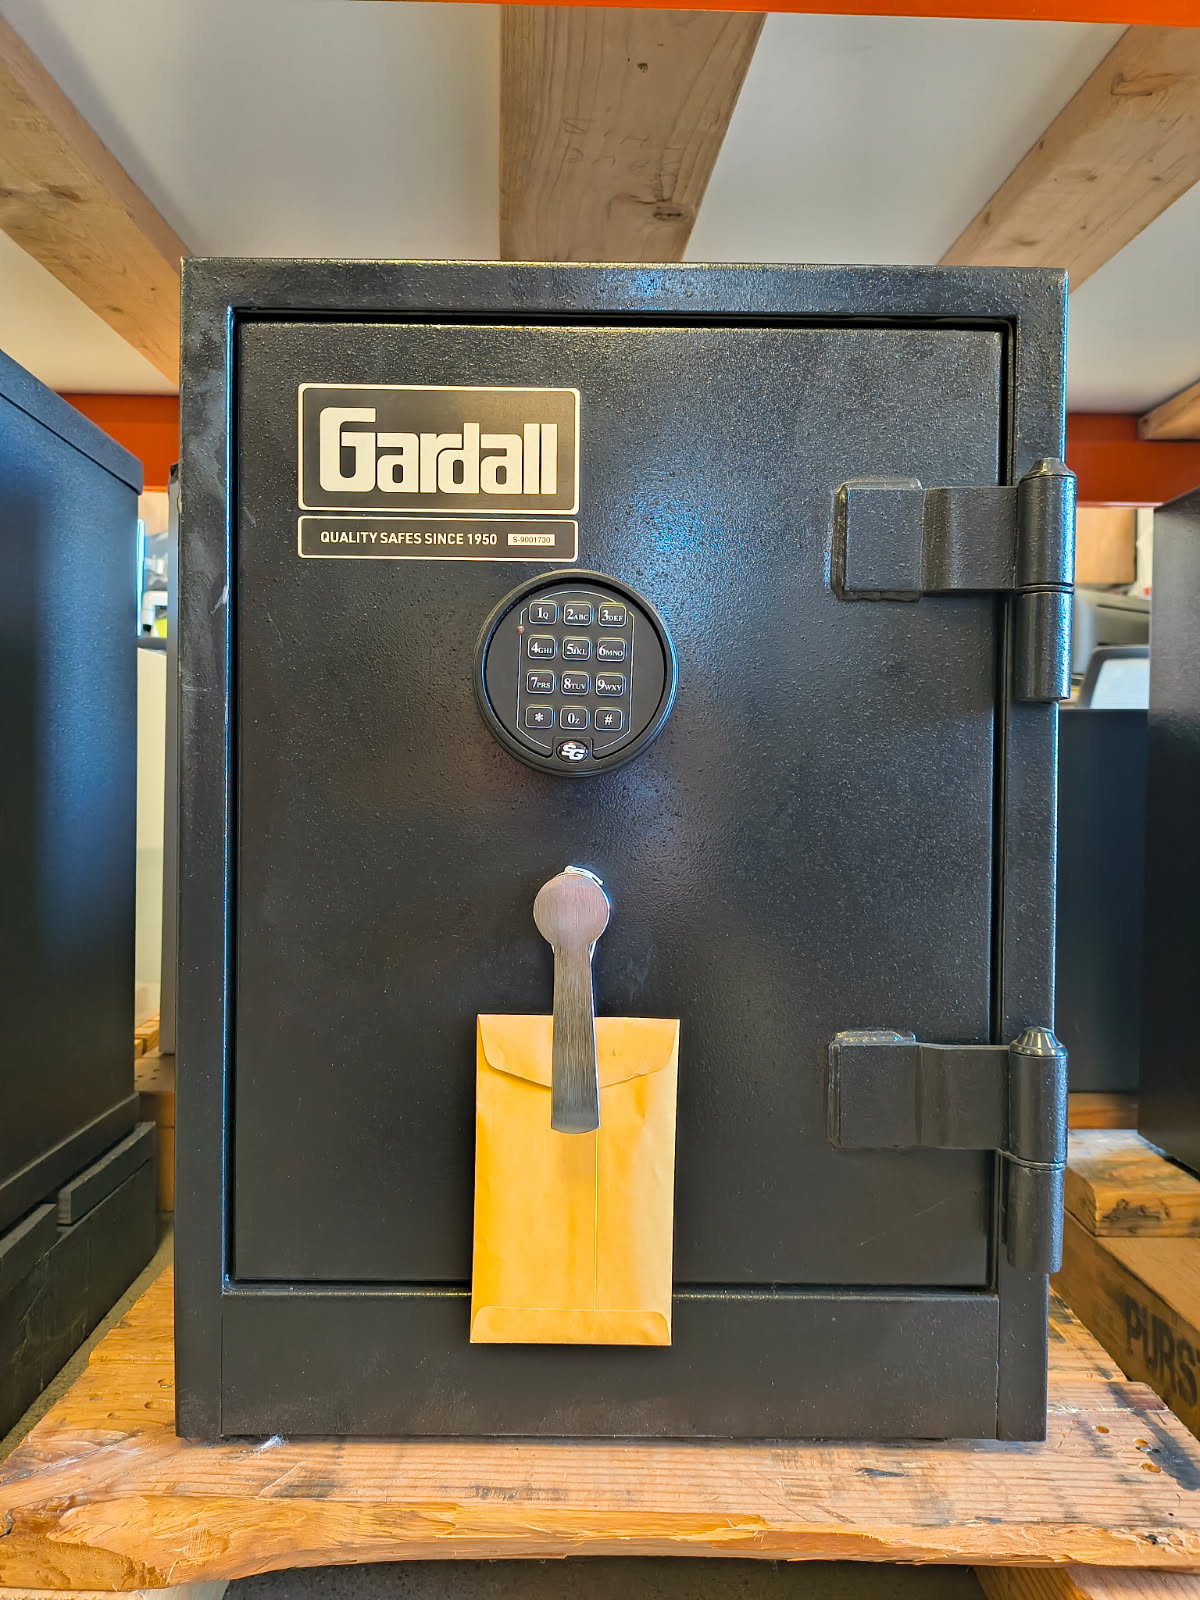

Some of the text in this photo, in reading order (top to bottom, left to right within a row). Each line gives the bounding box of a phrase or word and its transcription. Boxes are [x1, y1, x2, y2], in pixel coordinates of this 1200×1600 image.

[319, 407, 558, 495] Gardall
[320, 531, 498, 545] QUALITY SAFES SINCE 1950
[512, 535, 551, 544] S-9001730
[1124, 1296, 1200, 1408] PURS
